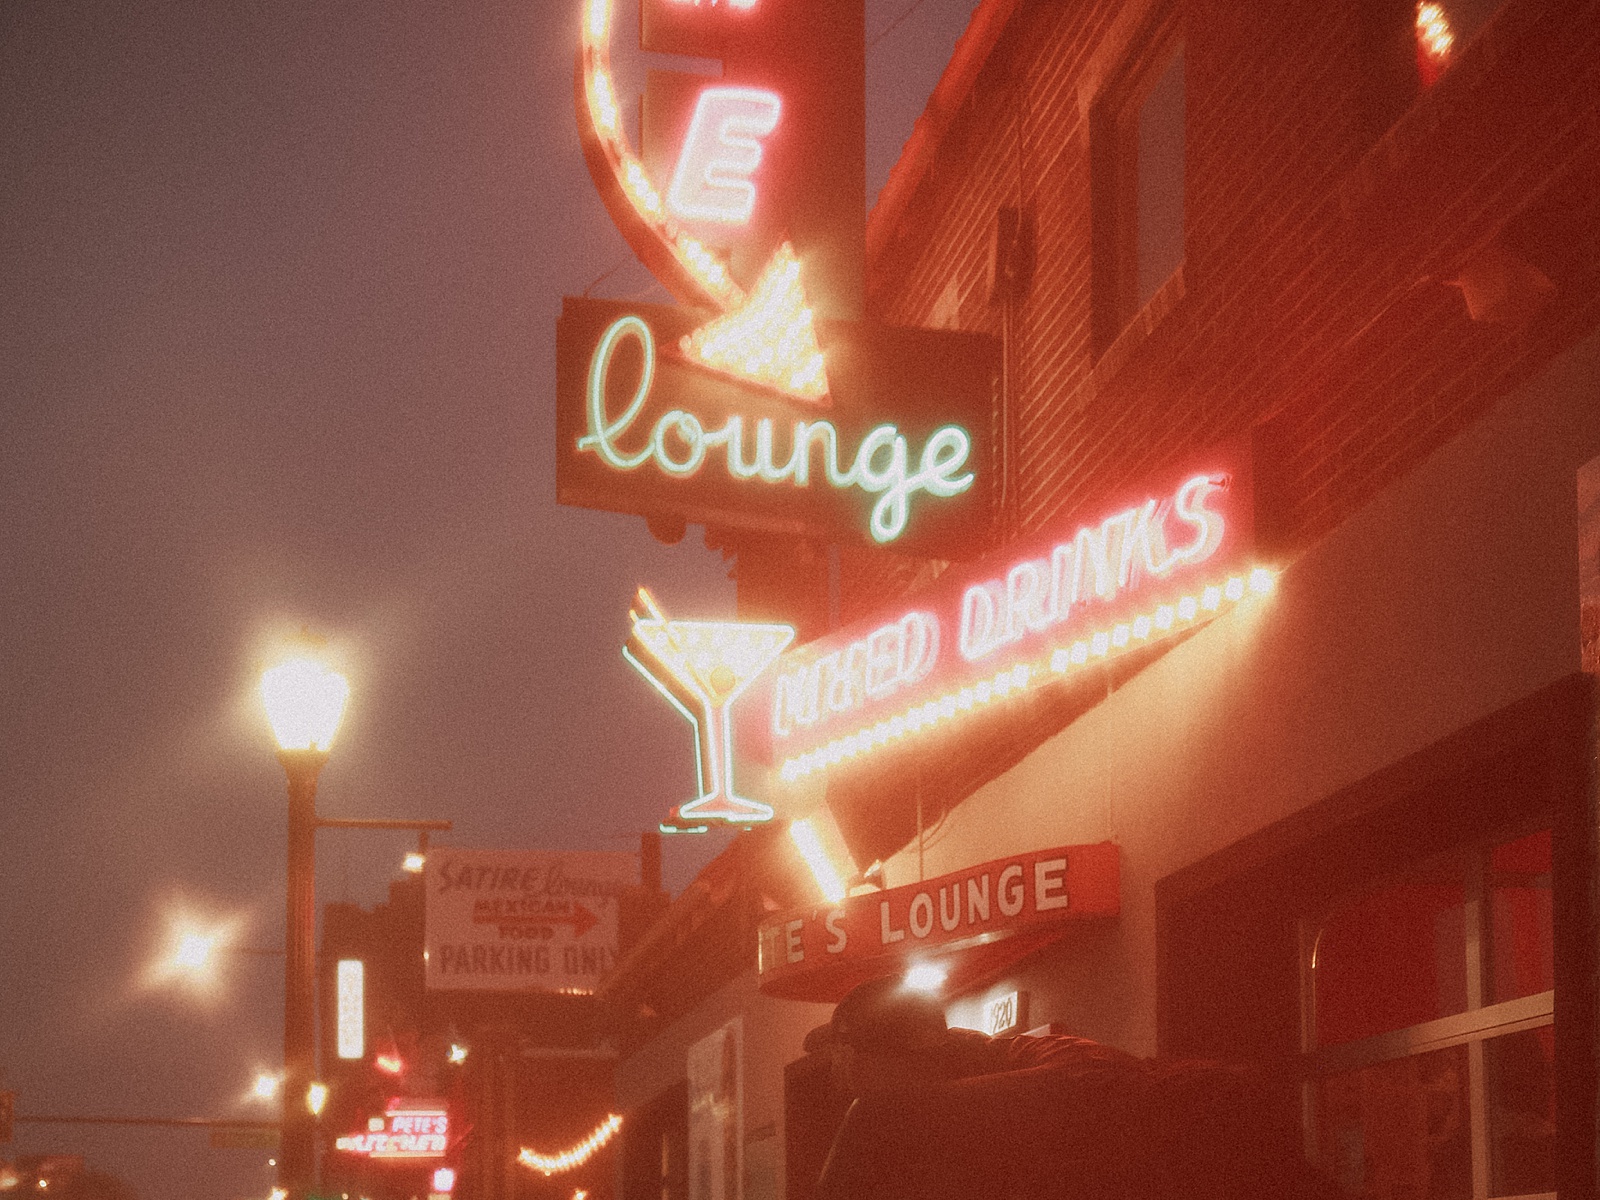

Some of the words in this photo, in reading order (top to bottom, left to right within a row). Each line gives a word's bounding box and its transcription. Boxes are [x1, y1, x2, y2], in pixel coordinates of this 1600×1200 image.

[577, 316, 976, 543] lounge
[772, 611, 941, 738] MIXED
[958, 473, 1230, 662] DRINKS
[473, 898, 570, 914] MEXICAN
[879, 858, 1069, 944] LOUNGE
[440, 944, 550, 976] PARKING
[392, 1116, 447, 1134] PETE'S
